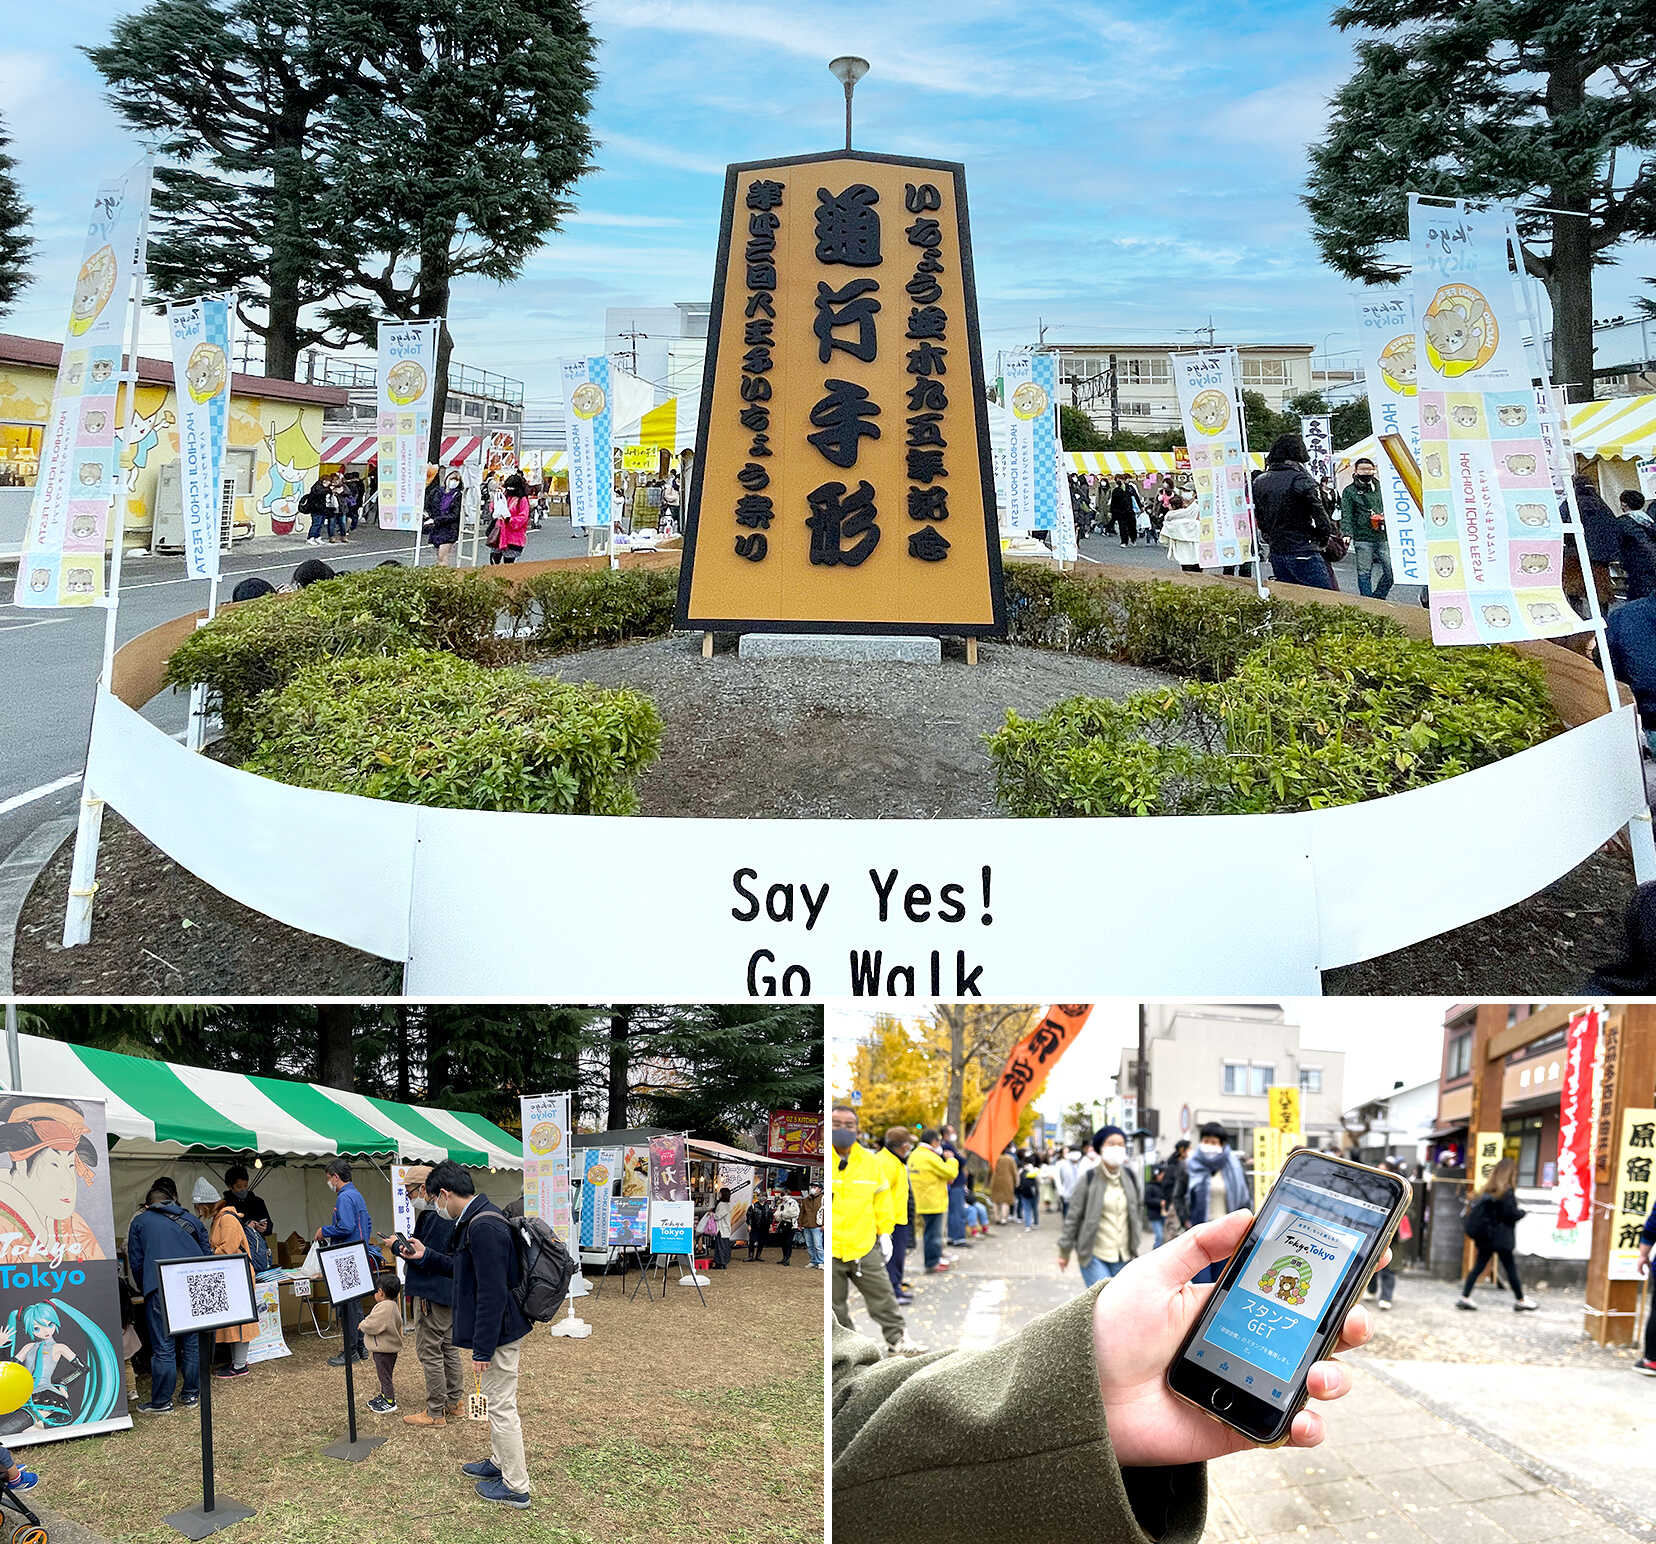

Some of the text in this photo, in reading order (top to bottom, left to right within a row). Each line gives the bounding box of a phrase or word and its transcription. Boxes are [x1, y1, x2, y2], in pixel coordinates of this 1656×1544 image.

[806, 183, 883, 568] 通行手形
[731, 864, 993, 931] Say Yes!
[747, 948, 984, 997] Go Walk
[660, 1228, 685, 1237] Tokyo
[1283, 1235, 1336, 1261] Tokyo Tokyo
[0, 1231, 83, 1269] Tokyo
[0, 1264, 86, 1293] Tokyo
[1241, 1298, 1299, 1330] スタンプ
[1247, 1319, 1276, 1339] GET
